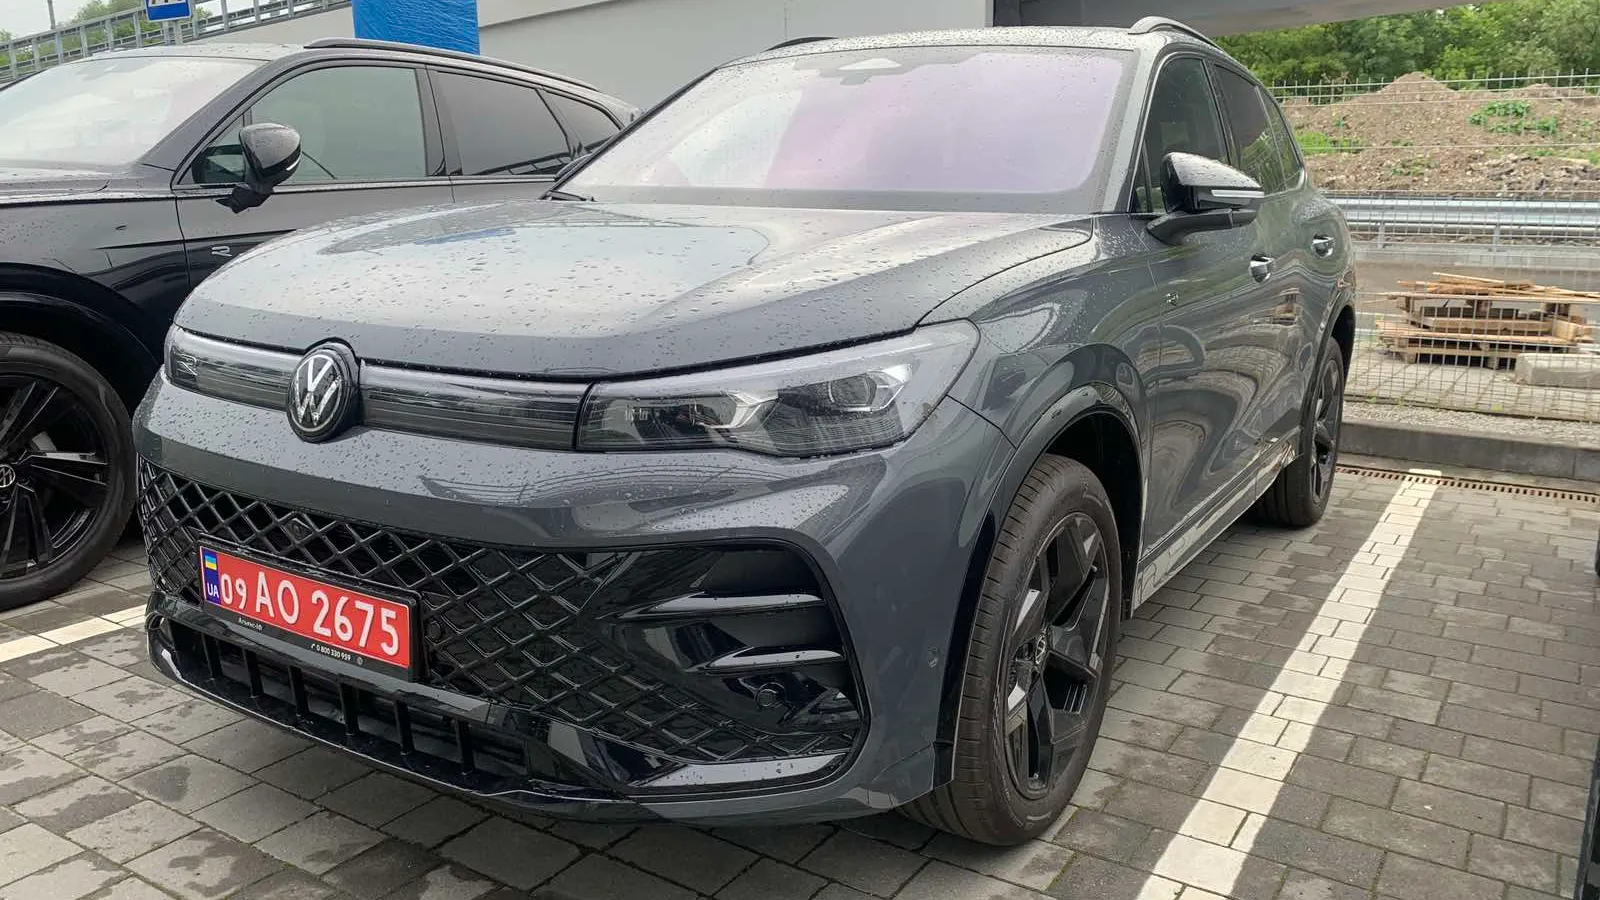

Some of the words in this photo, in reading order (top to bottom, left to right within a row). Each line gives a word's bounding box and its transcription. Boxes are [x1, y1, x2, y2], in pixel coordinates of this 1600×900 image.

[206, 582, 220, 599] UA
[220, 573, 247, 610] 09
[255, 571, 299, 625] AO
[311, 589, 399, 656] 2675
